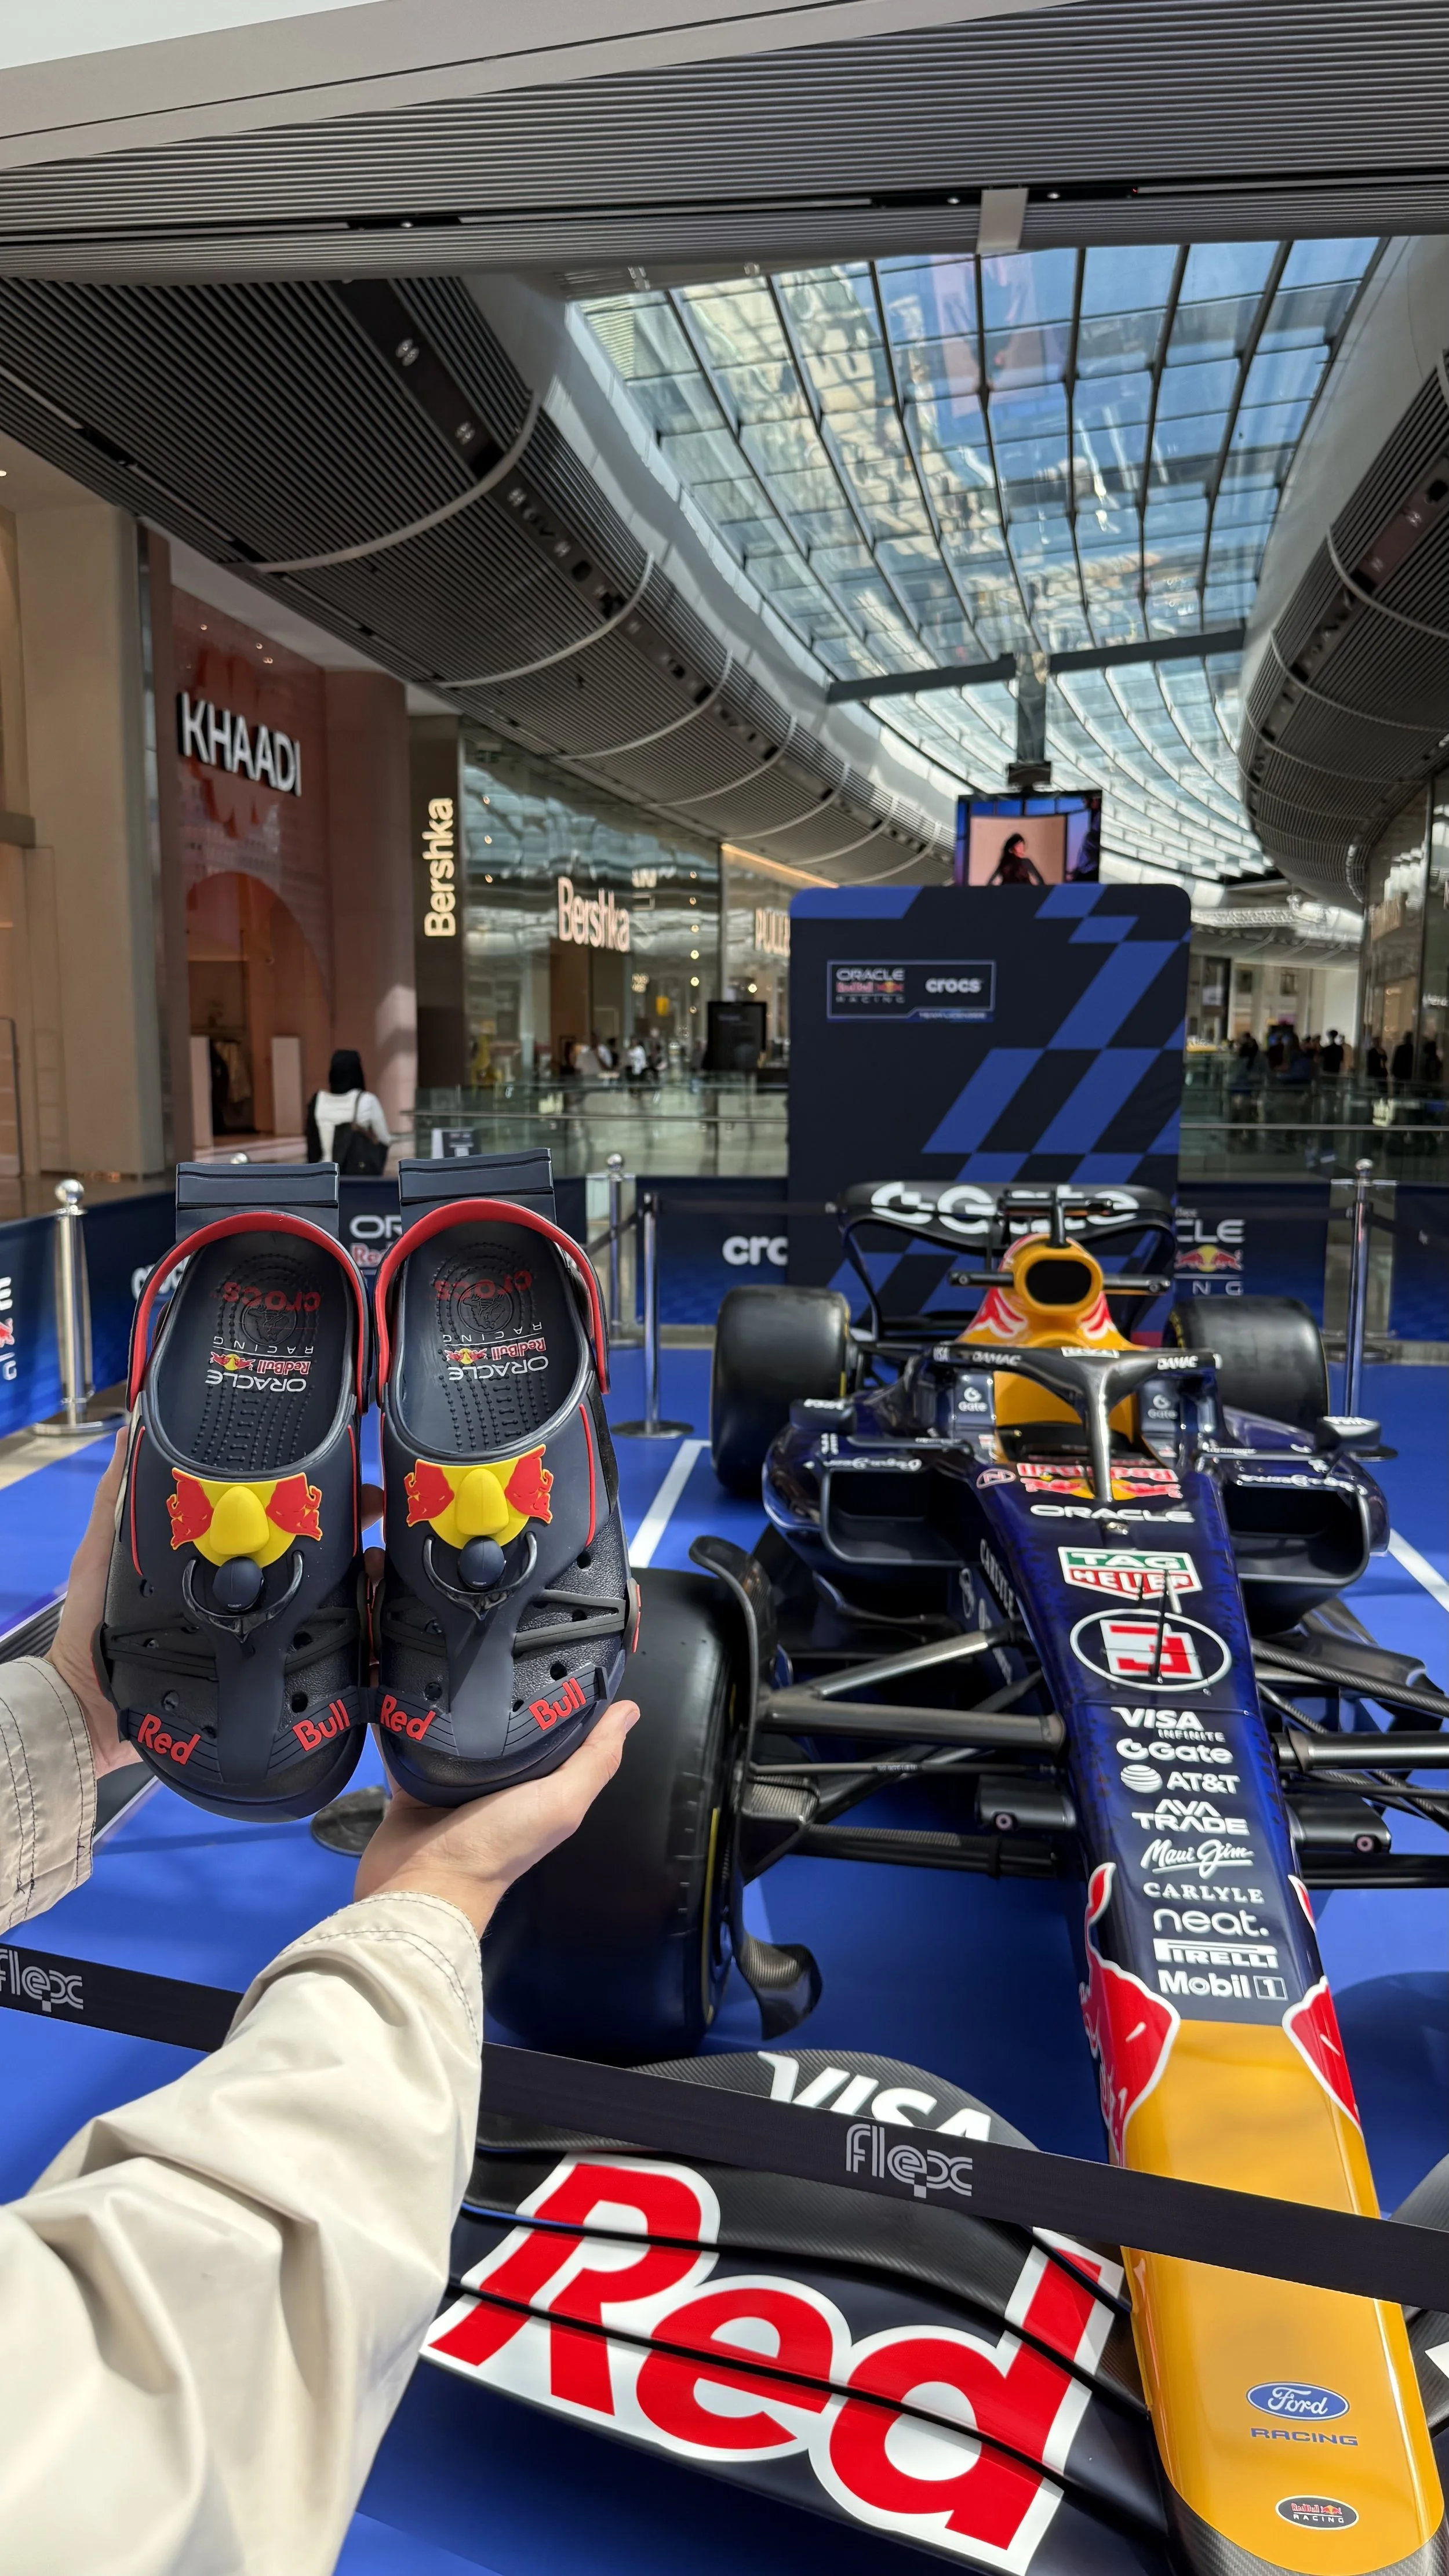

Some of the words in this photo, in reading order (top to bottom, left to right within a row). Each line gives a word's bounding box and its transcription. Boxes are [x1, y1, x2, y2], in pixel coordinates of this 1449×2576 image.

[180, 692, 302, 797] KHAADI
[422, 798, 456, 937] Bershka
[558, 876, 630, 953] Bershka
[836, 967, 905, 981] ORACLE
[925, 978, 982, 993] crocs
[836, 994, 905, 1003] RACING
[223, 1281, 322, 1312] crocs
[434, 1269, 533, 1301] crocs
[443, 1322, 543, 1342] RACING
[213, 1336, 314, 1354] RACING
[447, 1355, 549, 1381] ORACLE
[972, 1351, 1022, 1367] DAMAC
[205, 1369, 307, 1392] ORACLE
[958, 1401, 988, 1412] Gate
[1030, 1504, 1196, 1523] ORACLE
[1071, 1552, 1181, 1569] TAG
[1072, 1570, 1189, 1593] HEUER
[380, 1694, 436, 1741] Red
[528, 1677, 587, 1731] Bull
[1111, 1707, 1204, 1731] VISA
[136, 1712, 202, 1766] Red
[292, 1698, 350, 1752] Bull
[1157, 1729, 1225, 1742] INFINITE
[1148, 1741, 1233, 1764] Gate
[1166, 1772, 1240, 1794] AT&T
[1155, 1799, 1222, 1818] AVA
[1131, 1812, 1251, 1836] TRADE
[1140, 1839, 1195, 1869] Maui
[1196, 1839, 1255, 1880] Jim
[1143, 1882, 1265, 1904] CARLYLE
[1153, 1909, 1270, 1937] neat.
[1153, 1938, 1279, 1969] PIRELLI
[1157, 1970, 1252, 1999] Mobil
[844, 2123, 974, 2199] flex
[422, 2157, 1110, 2562] Red
[1267, 2386, 1329, 2415] Ford
[1250, 2426, 1359, 2447] RACING
[1293, 2513, 1345, 2523] RACING
